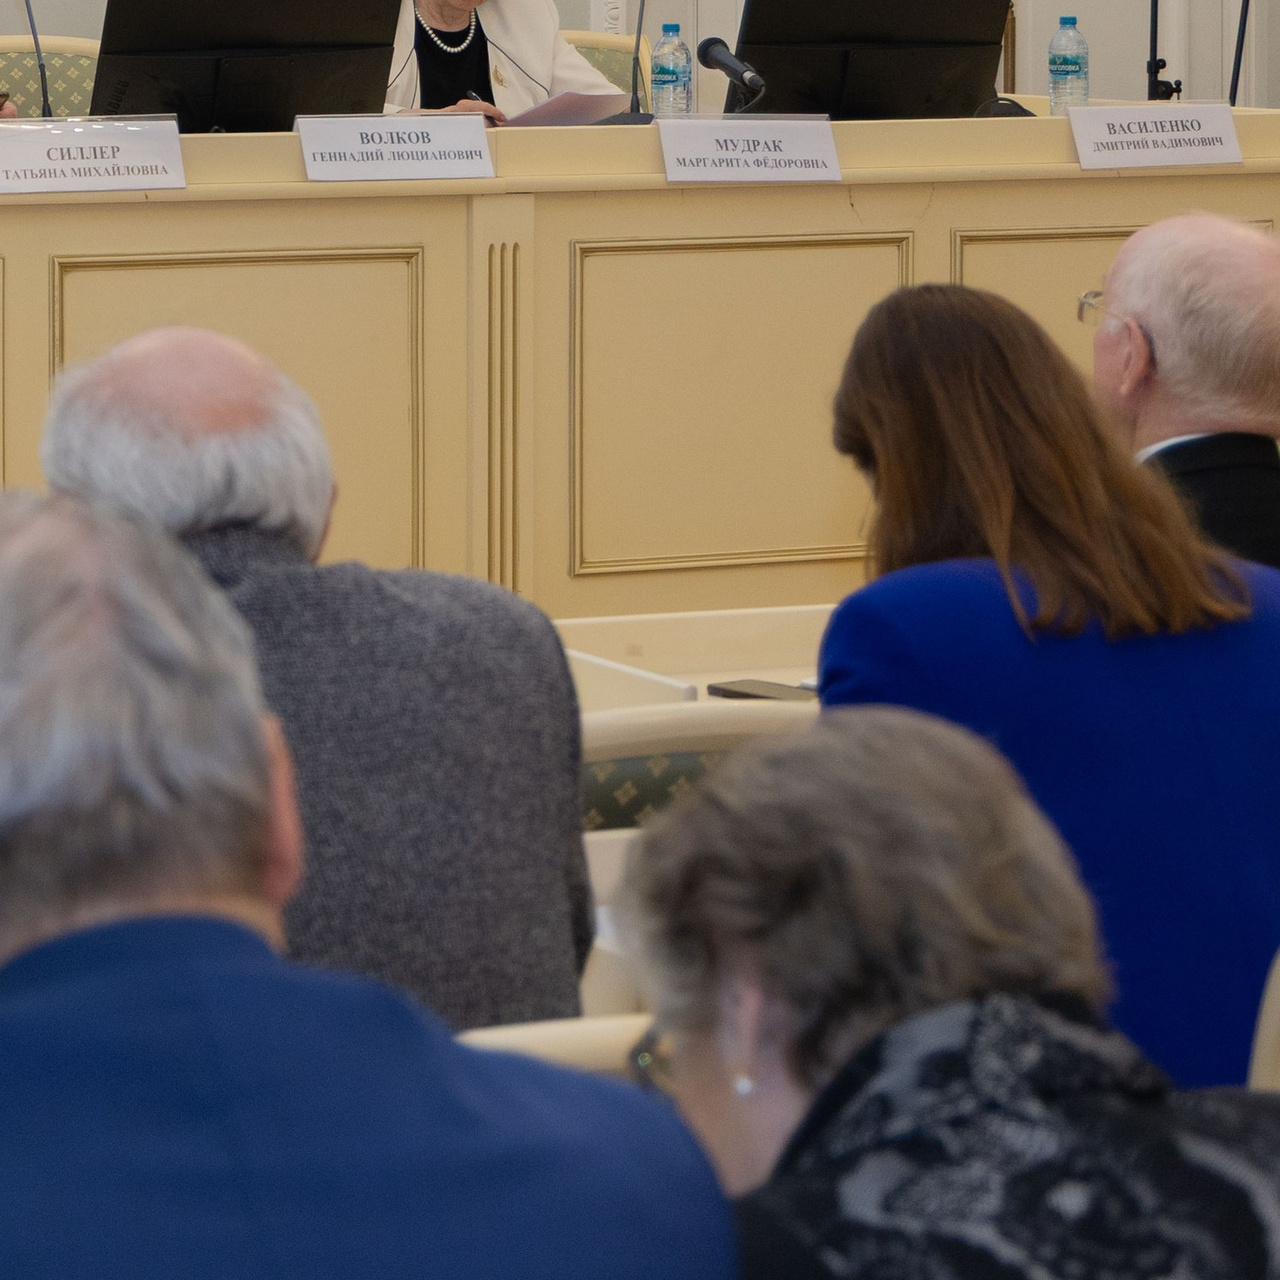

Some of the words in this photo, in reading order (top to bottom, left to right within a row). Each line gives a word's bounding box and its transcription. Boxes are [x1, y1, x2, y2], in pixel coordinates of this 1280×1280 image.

[1106, 119, 1202, 135] ВАСИЛЕНКО
[359, 131, 432, 145] ВОЛКОВ
[714, 138, 783, 153] МУДРАК
[1093, 137, 1150, 153] ДМИТРИЙ
[1152, 136, 1224, 150] ВАДИМОВИЧ
[46, 145, 121, 161] СИЛЛЕР
[312, 149, 384, 163] ГЕННАДИЙ
[387, 149, 483, 162] ЛЮЦИАНОВИЧ
[676, 157, 750, 168] МАРГАРИТА
[753, 156, 828, 169] ФЁДОРОВНА
[2, 168, 67, 181] ТАТЬЯНА
[70, 163, 169, 179] МИХАЙЛОВНА
